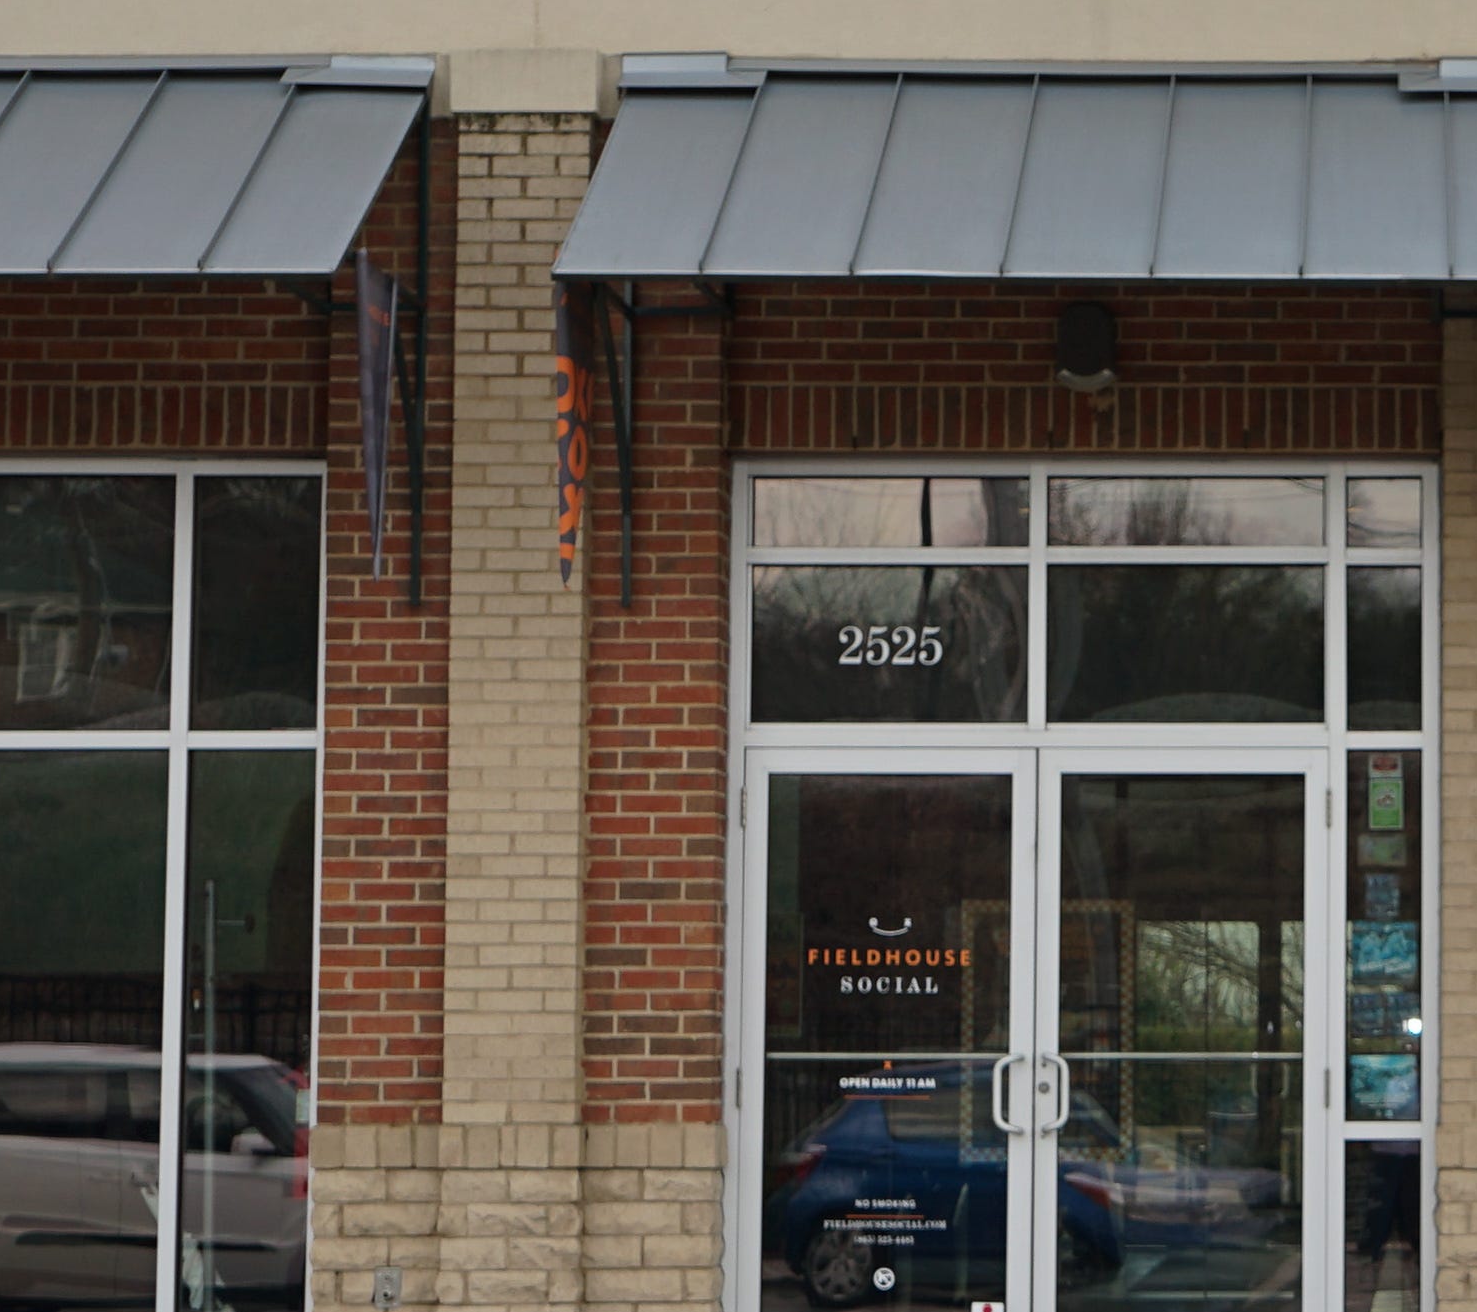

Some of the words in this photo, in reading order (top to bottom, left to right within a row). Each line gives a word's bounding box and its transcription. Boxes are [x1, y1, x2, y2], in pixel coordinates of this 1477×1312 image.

[837, 624, 944, 667] 2525
[807, 948, 972, 967] FIELDHOUSE
[839, 975, 939, 994] SOCIAL
[839, 1077, 870, 1089] OPEN
[872, 1077, 904, 1089] DAILY
[917, 1077, 936, 1089] AM
[854, 1198, 870, 1209] NO
